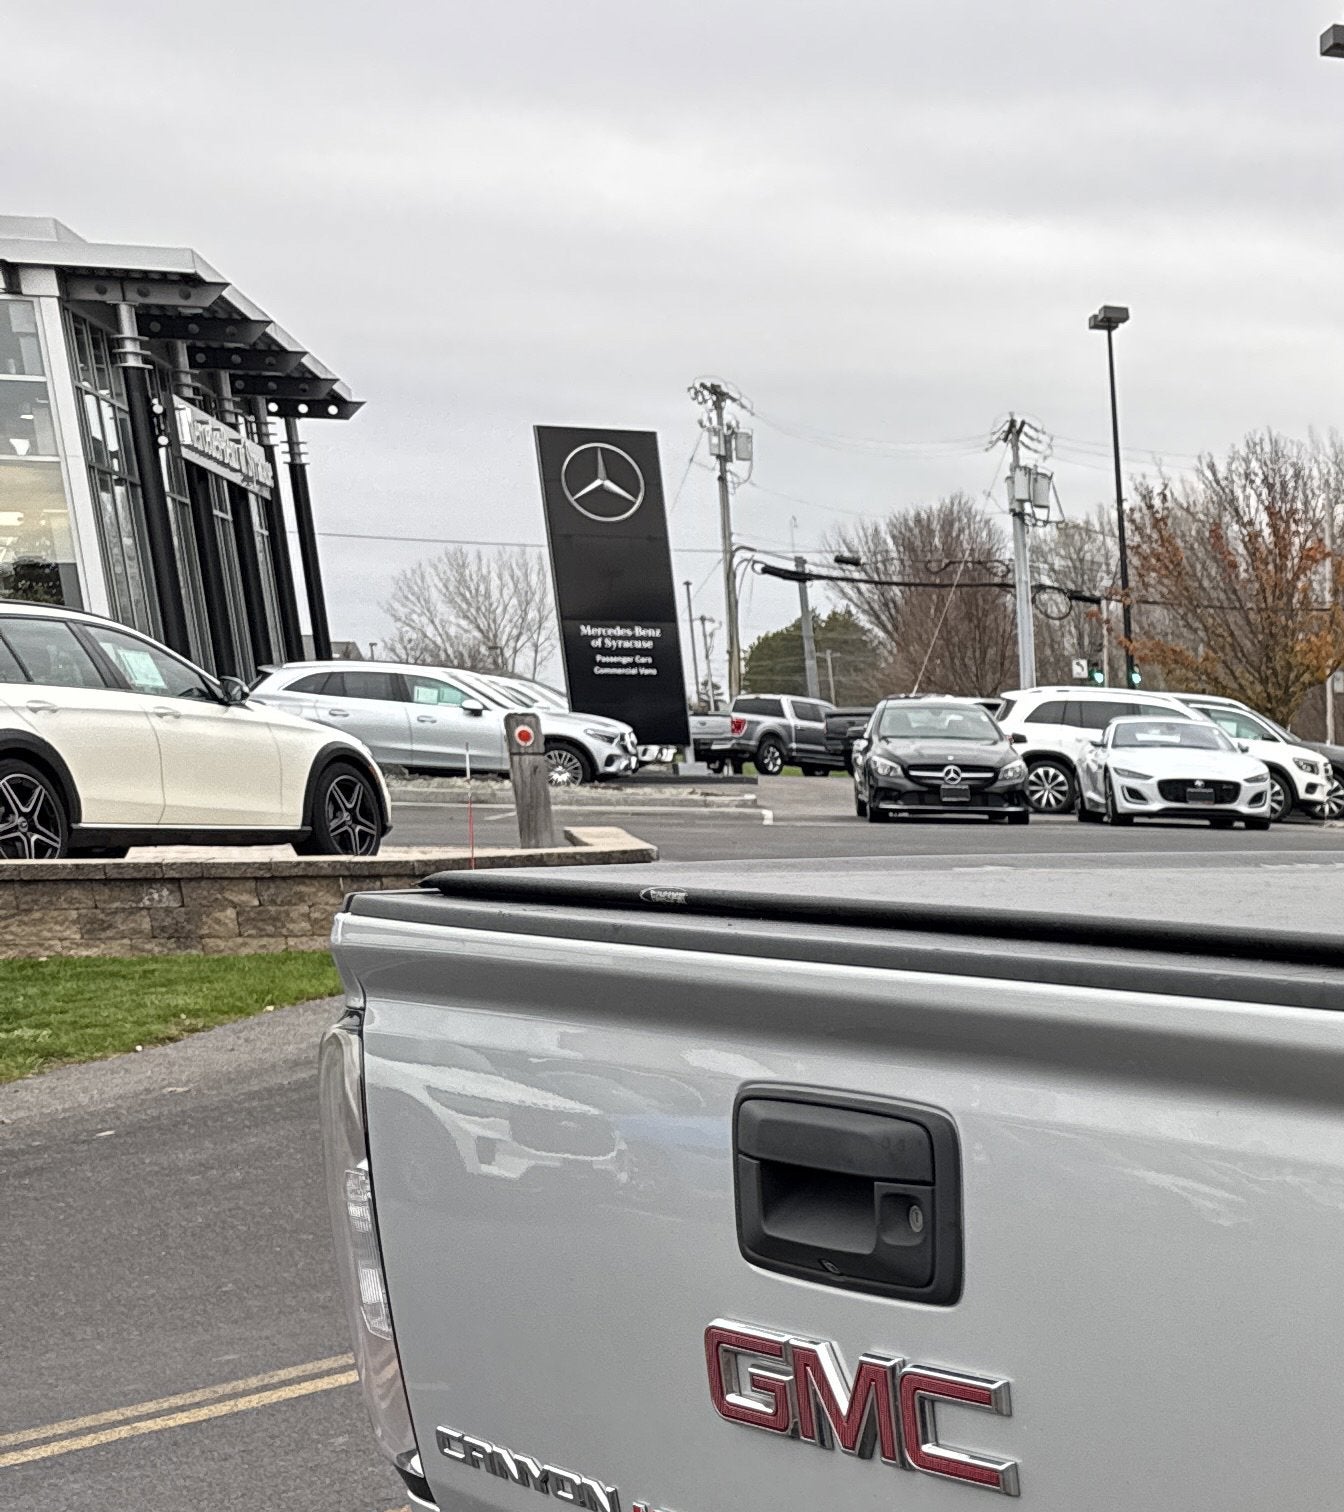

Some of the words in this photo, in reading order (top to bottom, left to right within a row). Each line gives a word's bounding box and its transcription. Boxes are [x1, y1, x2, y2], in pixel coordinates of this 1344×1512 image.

[590, 637, 602, 648] of
[604, 637, 653, 650] Syracuse
[704, 1317, 1020, 1497] GMC
